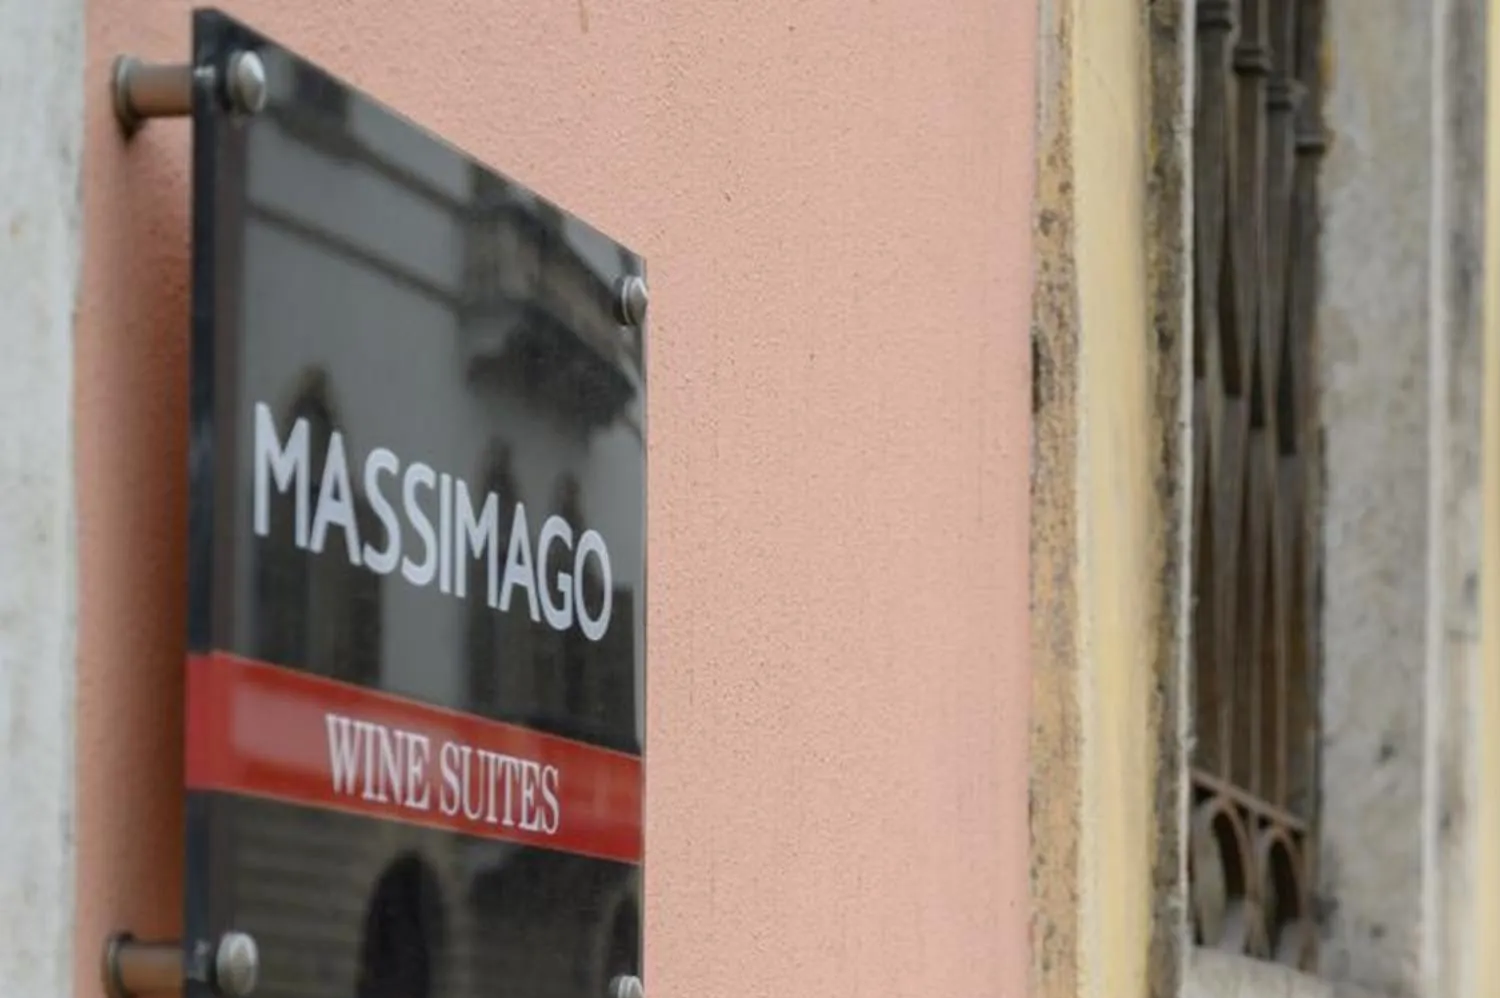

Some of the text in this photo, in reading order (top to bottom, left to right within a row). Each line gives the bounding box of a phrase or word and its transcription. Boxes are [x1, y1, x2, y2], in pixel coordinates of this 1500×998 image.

[254, 401, 613, 641] MASSIMAGO
[325, 713, 560, 834] WINE SUITES
